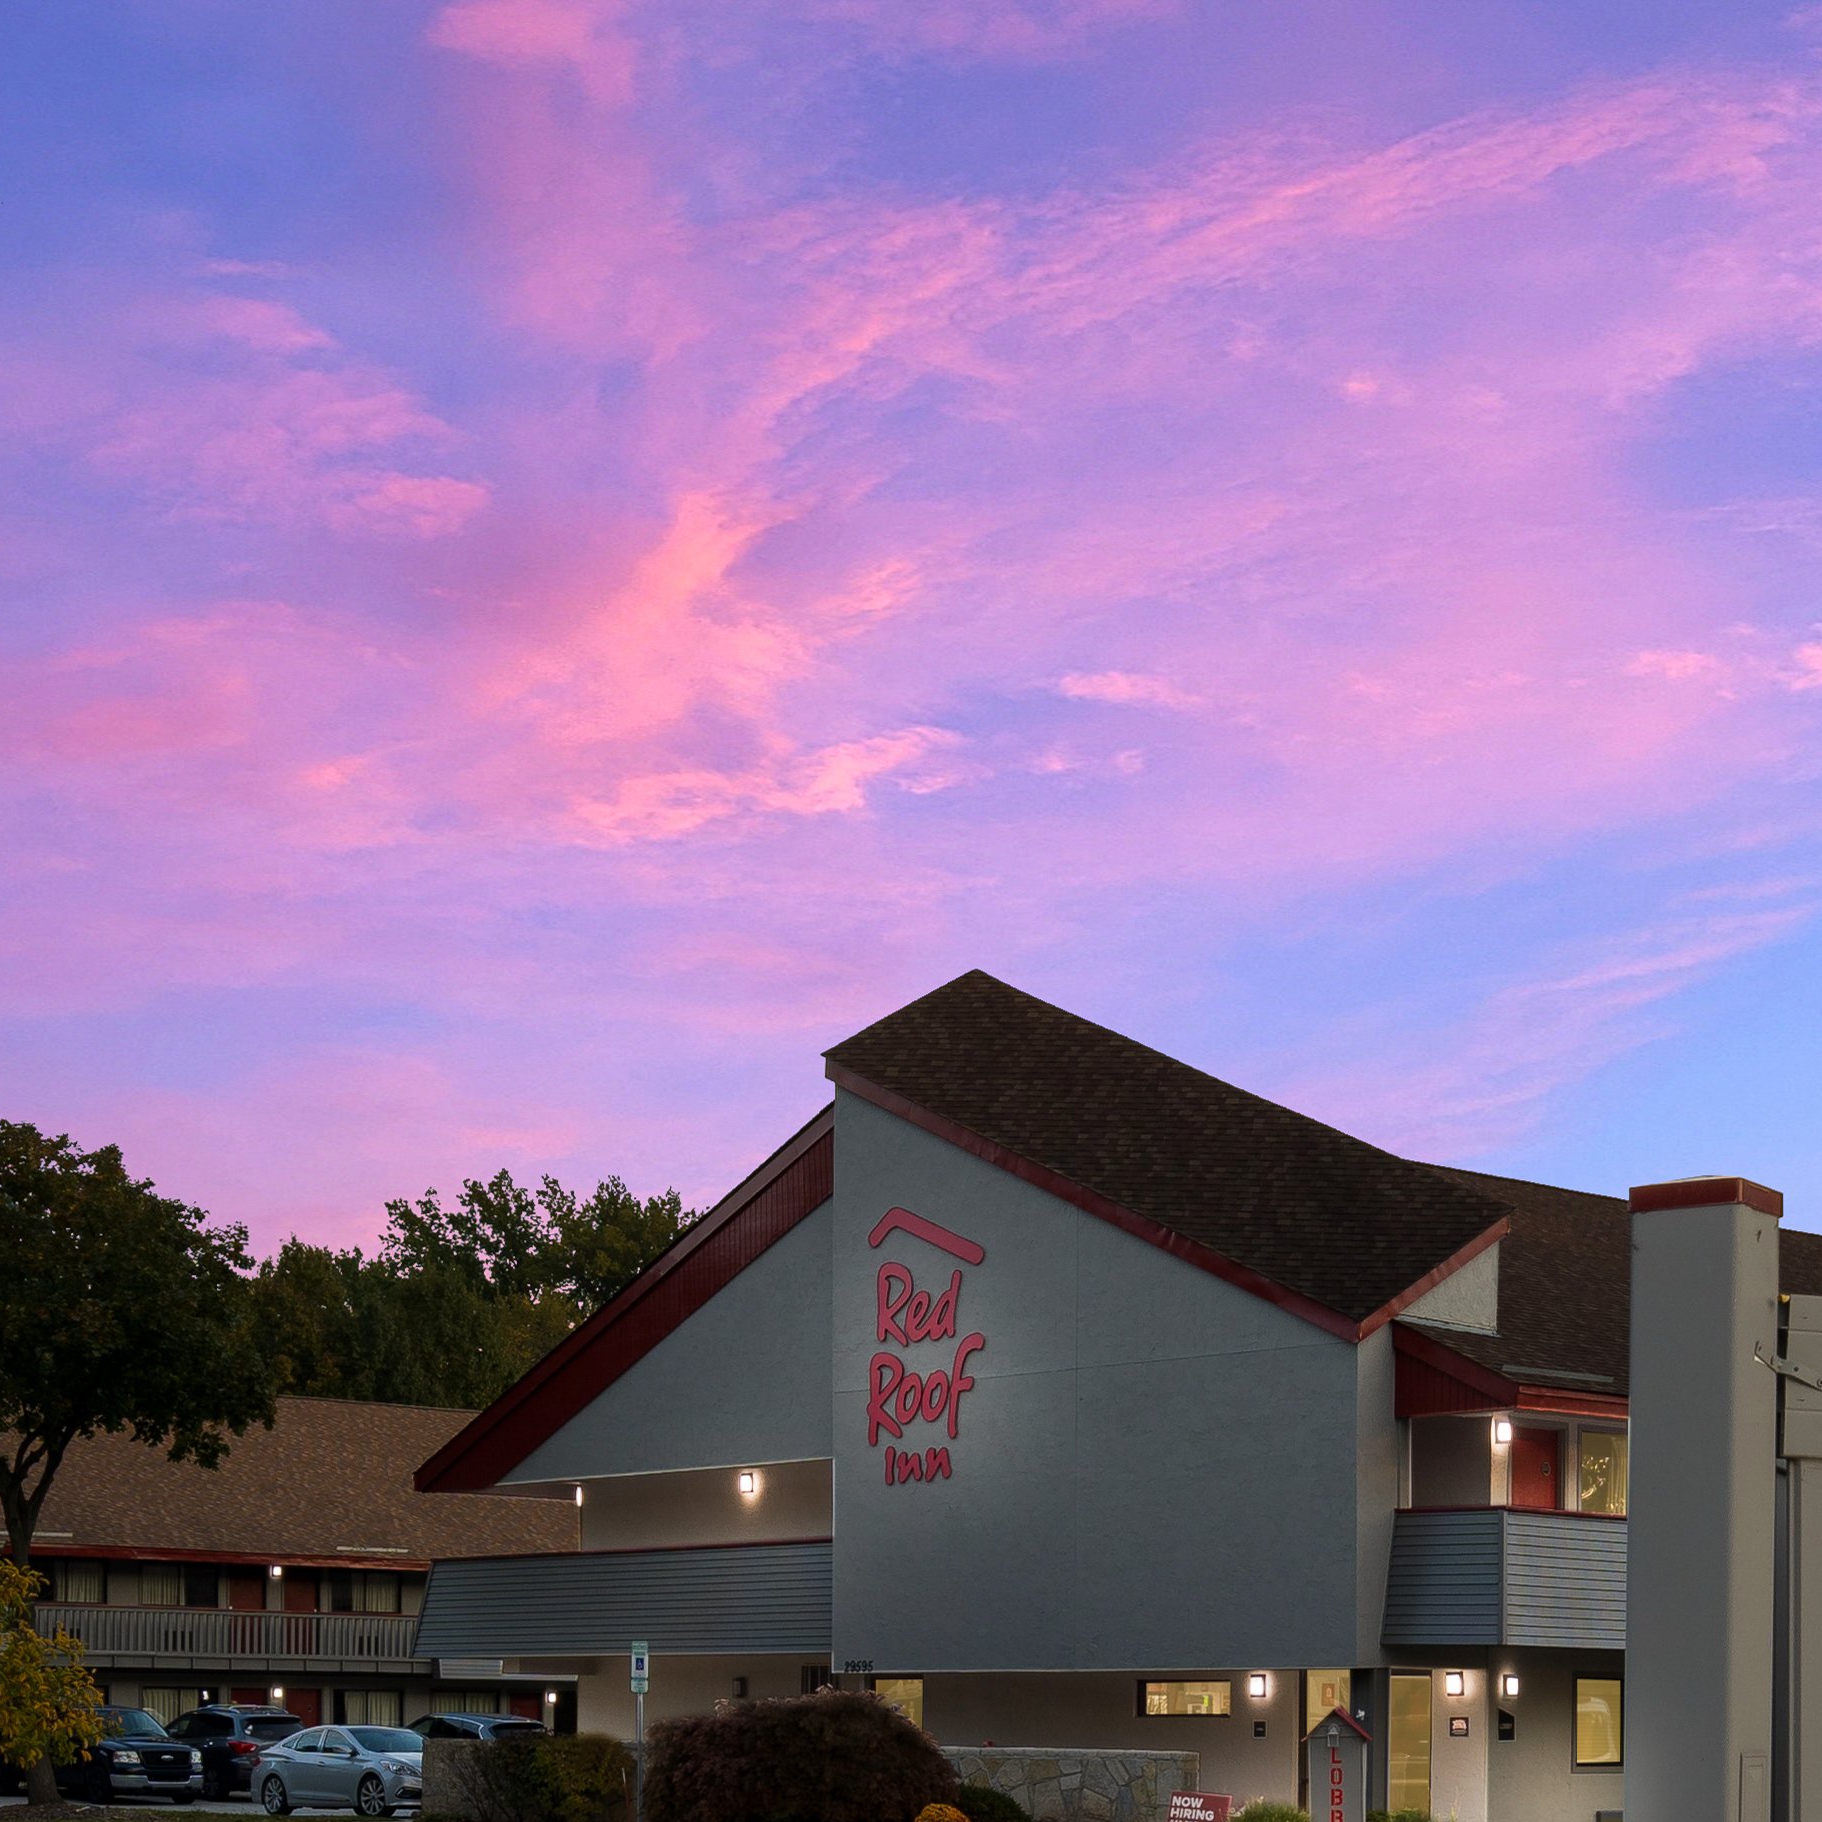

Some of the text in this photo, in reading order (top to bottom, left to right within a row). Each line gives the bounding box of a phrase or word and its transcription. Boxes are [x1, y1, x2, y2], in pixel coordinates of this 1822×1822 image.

[877, 1261, 962, 1347] Red
[866, 1331, 985, 1447] Roof
[885, 1445, 952, 1486] Inn
[844, 1660, 874, 1673] 29595
[1170, 1807, 1215, 1821] HIRING
[1171, 1795, 1204, 1808] NOW
